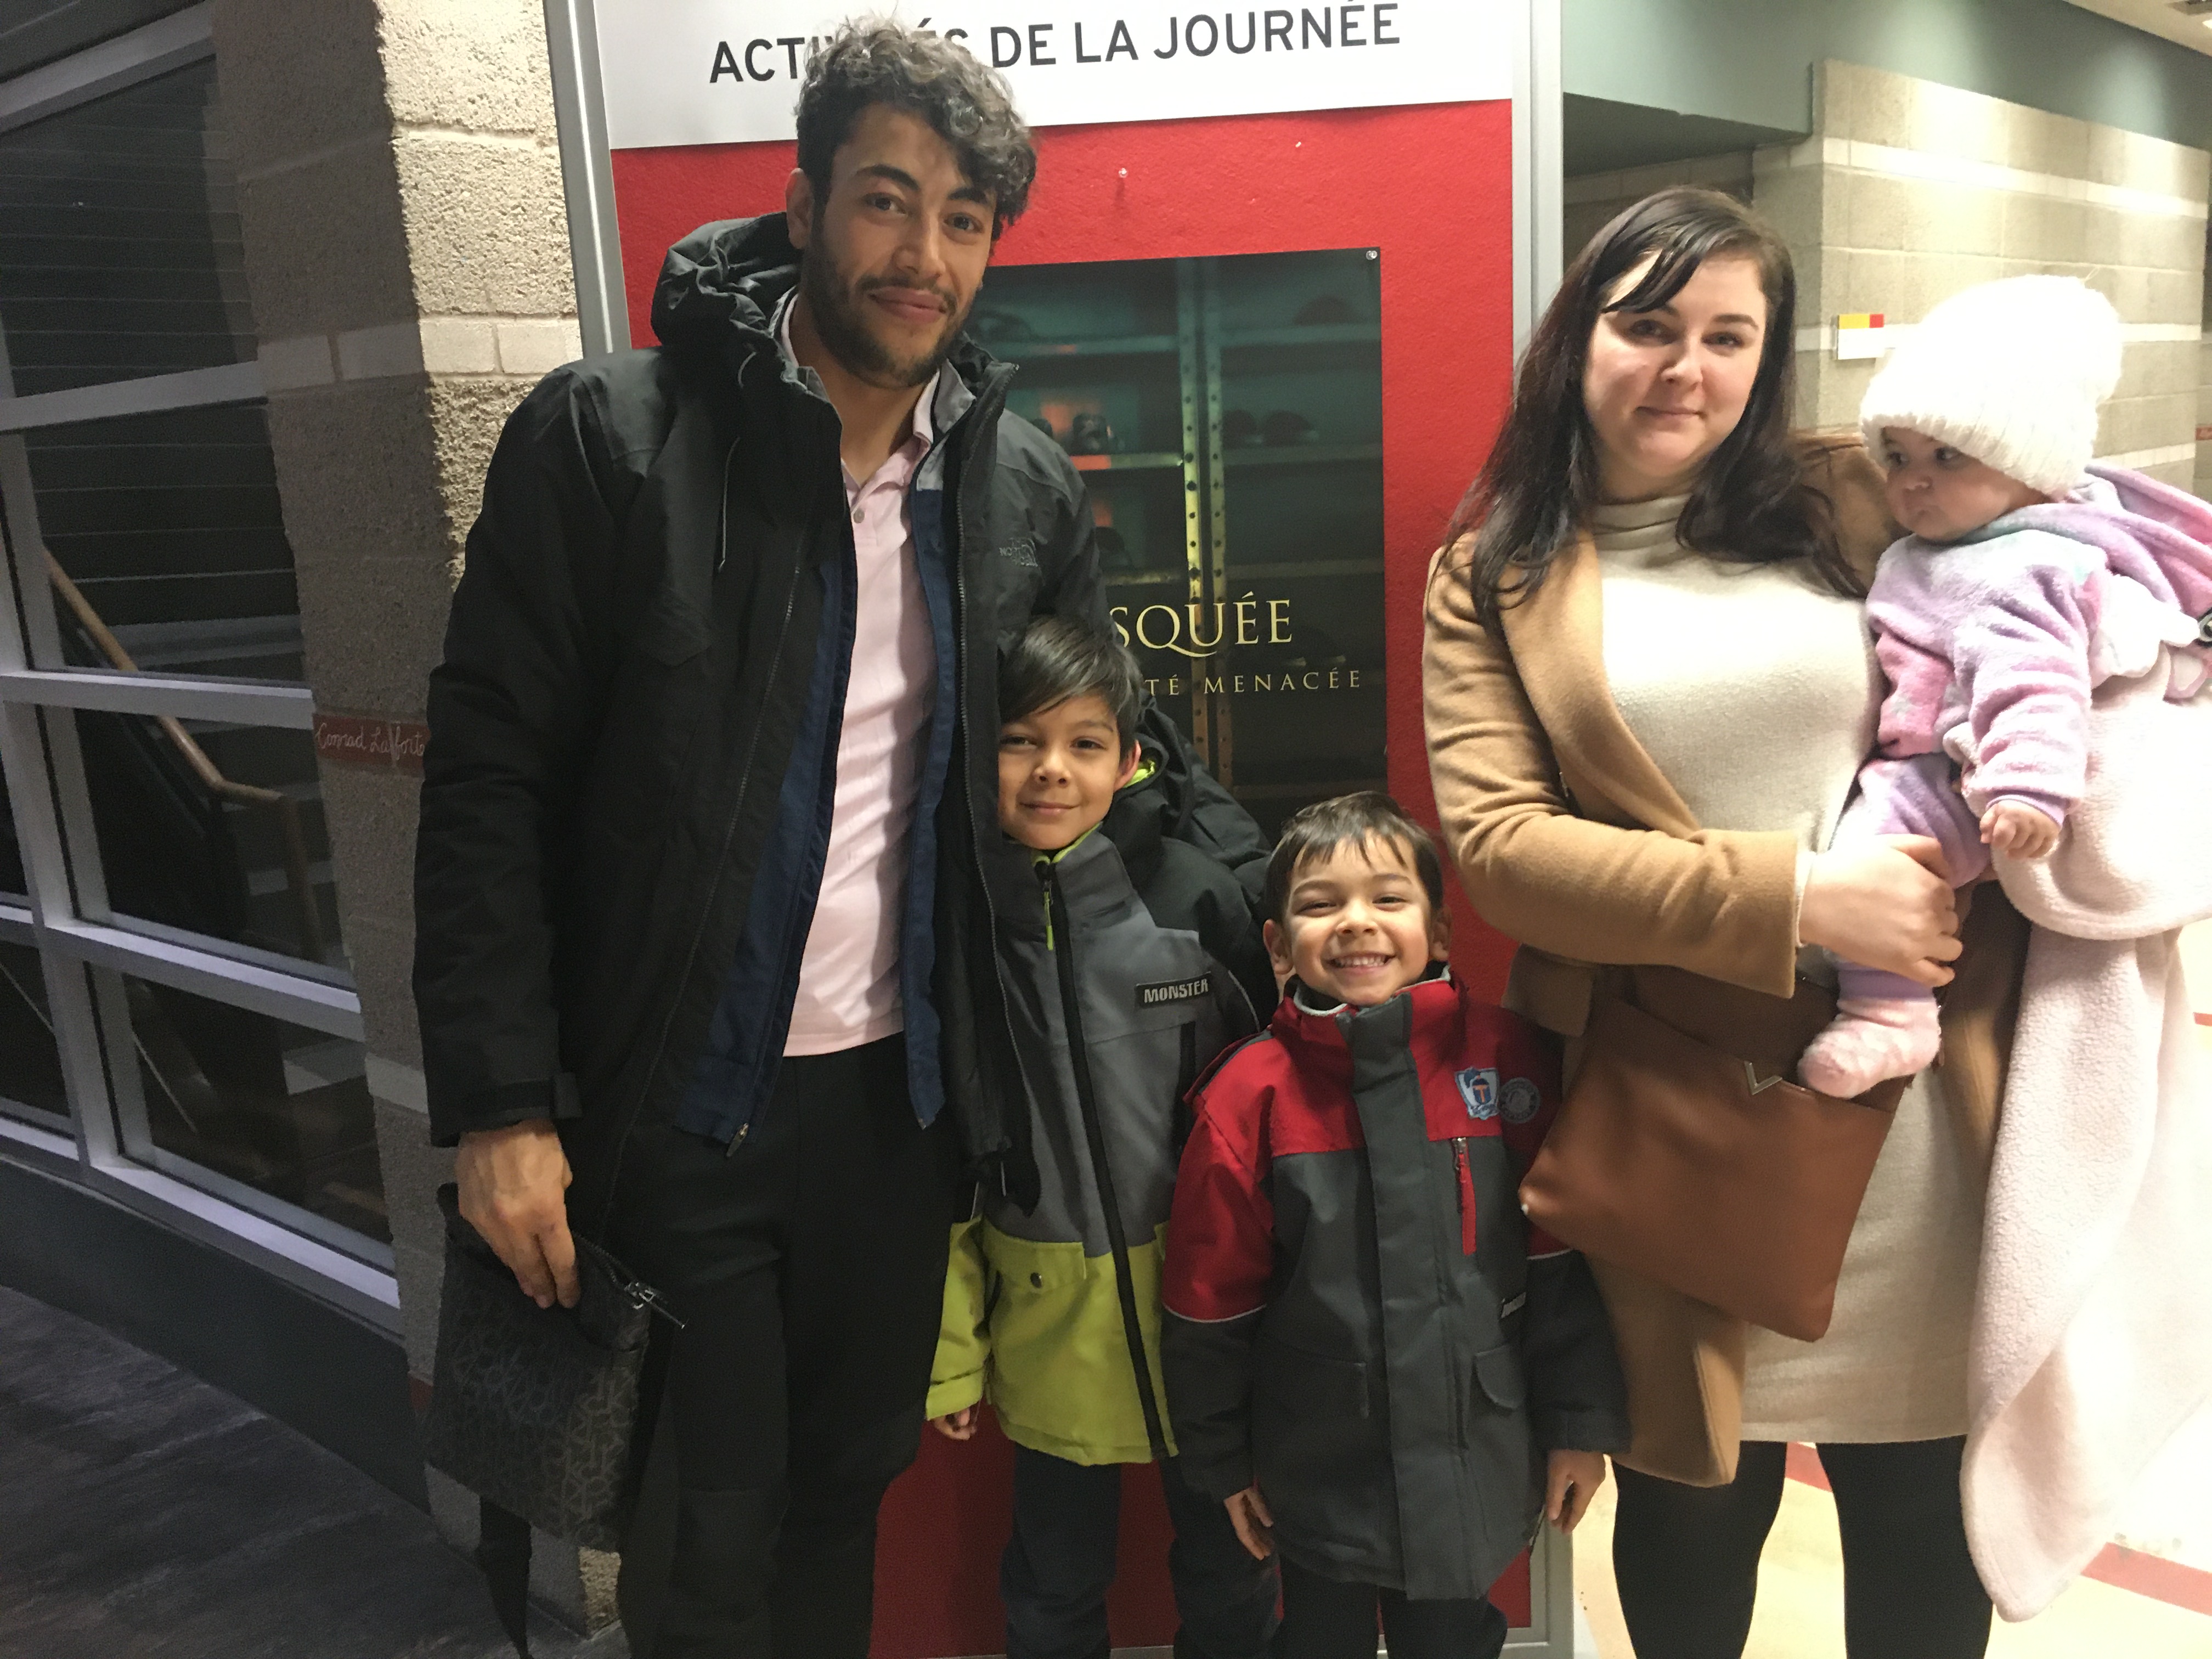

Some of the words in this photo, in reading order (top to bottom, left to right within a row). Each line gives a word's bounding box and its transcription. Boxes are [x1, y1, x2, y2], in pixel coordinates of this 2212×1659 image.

[990, 24, 1056, 67] DE
[1075, 19, 1138, 64] LA
[1153, 0, 1400, 59] JOURNÉE
[1109, 591, 1292, 657] SQUÉE
[1145, 674, 1180, 696] TÉ
[1204, 667, 1360, 693] MENACÉE
[315, 723, 366, 750] Conrad
[1144, 978, 1209, 1003] MONSTER
